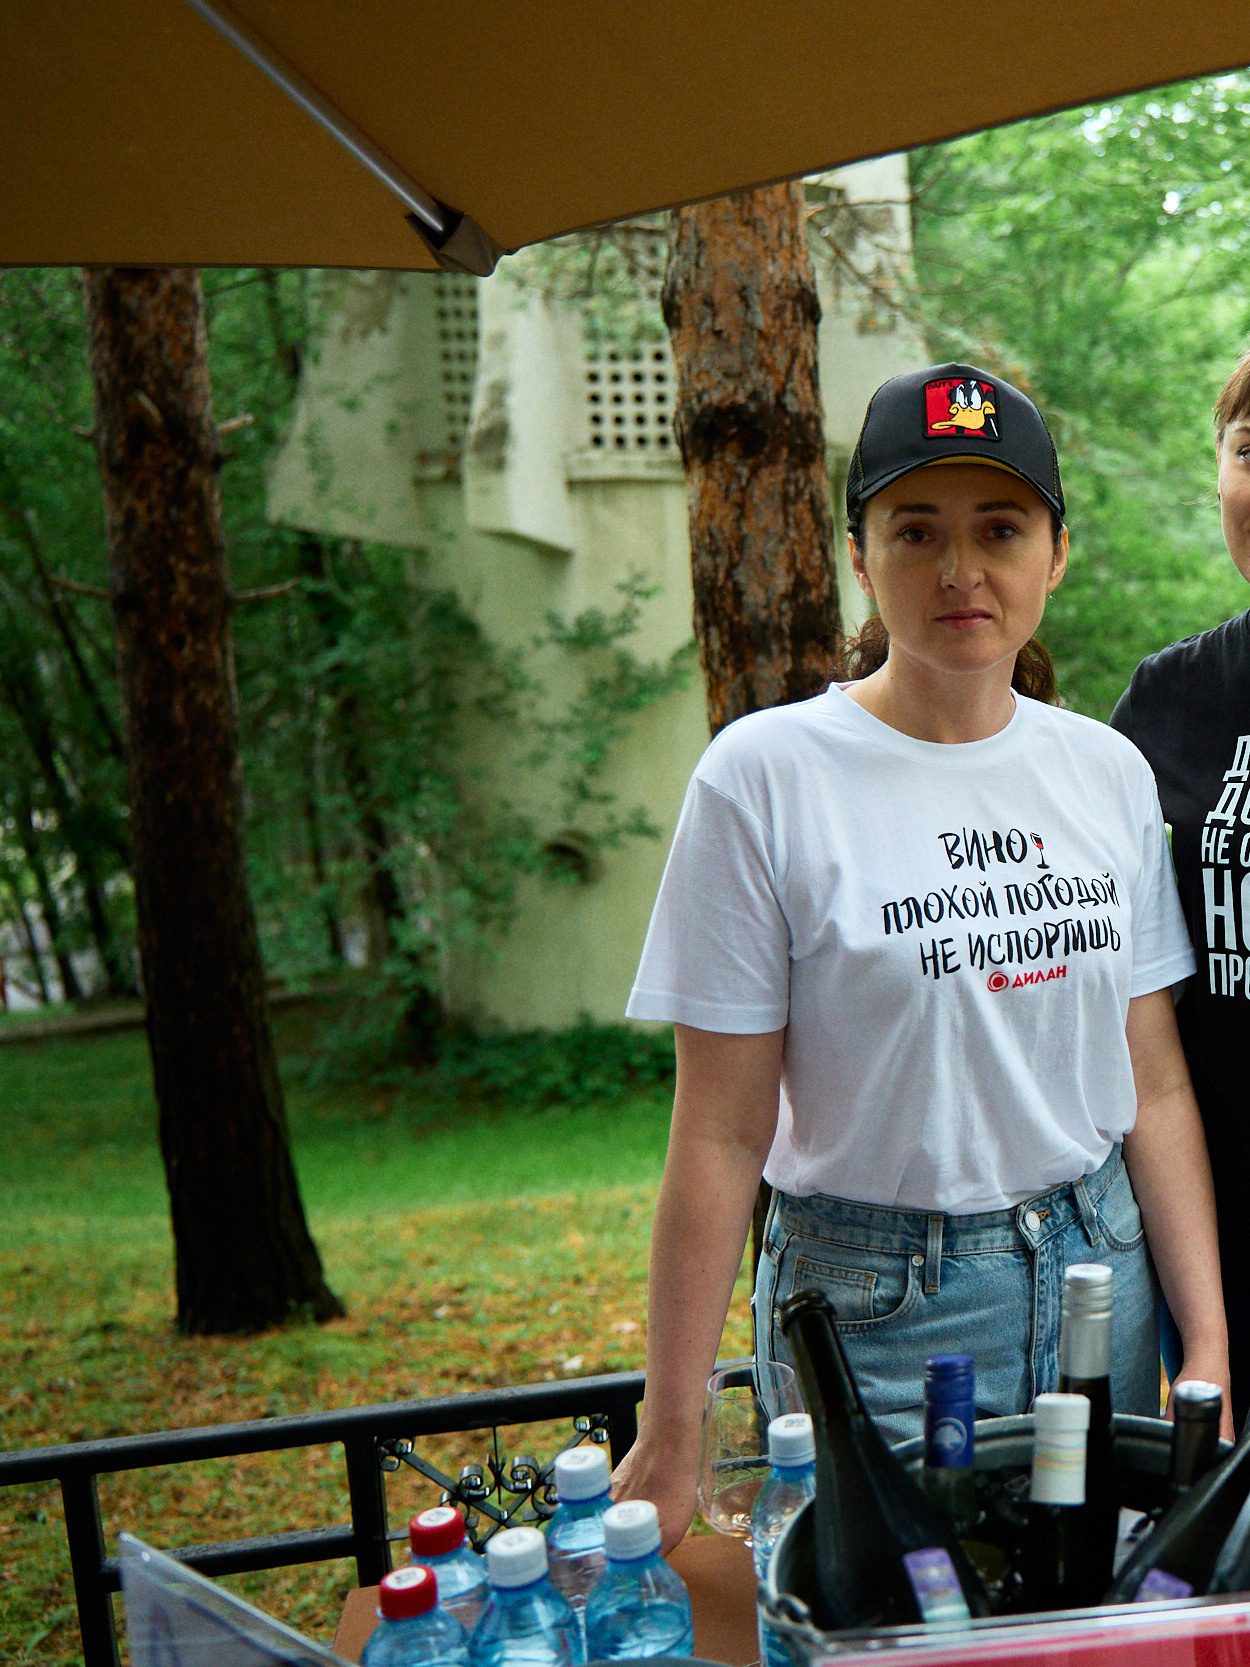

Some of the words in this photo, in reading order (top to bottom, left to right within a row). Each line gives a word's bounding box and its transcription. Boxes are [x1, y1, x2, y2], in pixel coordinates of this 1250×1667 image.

[938, 827, 1028, 872] ВИНО
[1201, 826, 1235, 864] НЕ
[881, 881, 999, 935] ПЛОХОЙ
[1003, 872, 1121, 916] ПОГОДОЙ
[919, 937, 962, 980] НЕ
[968, 915, 1121, 971] ИСПОРТИШЬ
[1011, 964, 1067, 990] ДИЛАН
